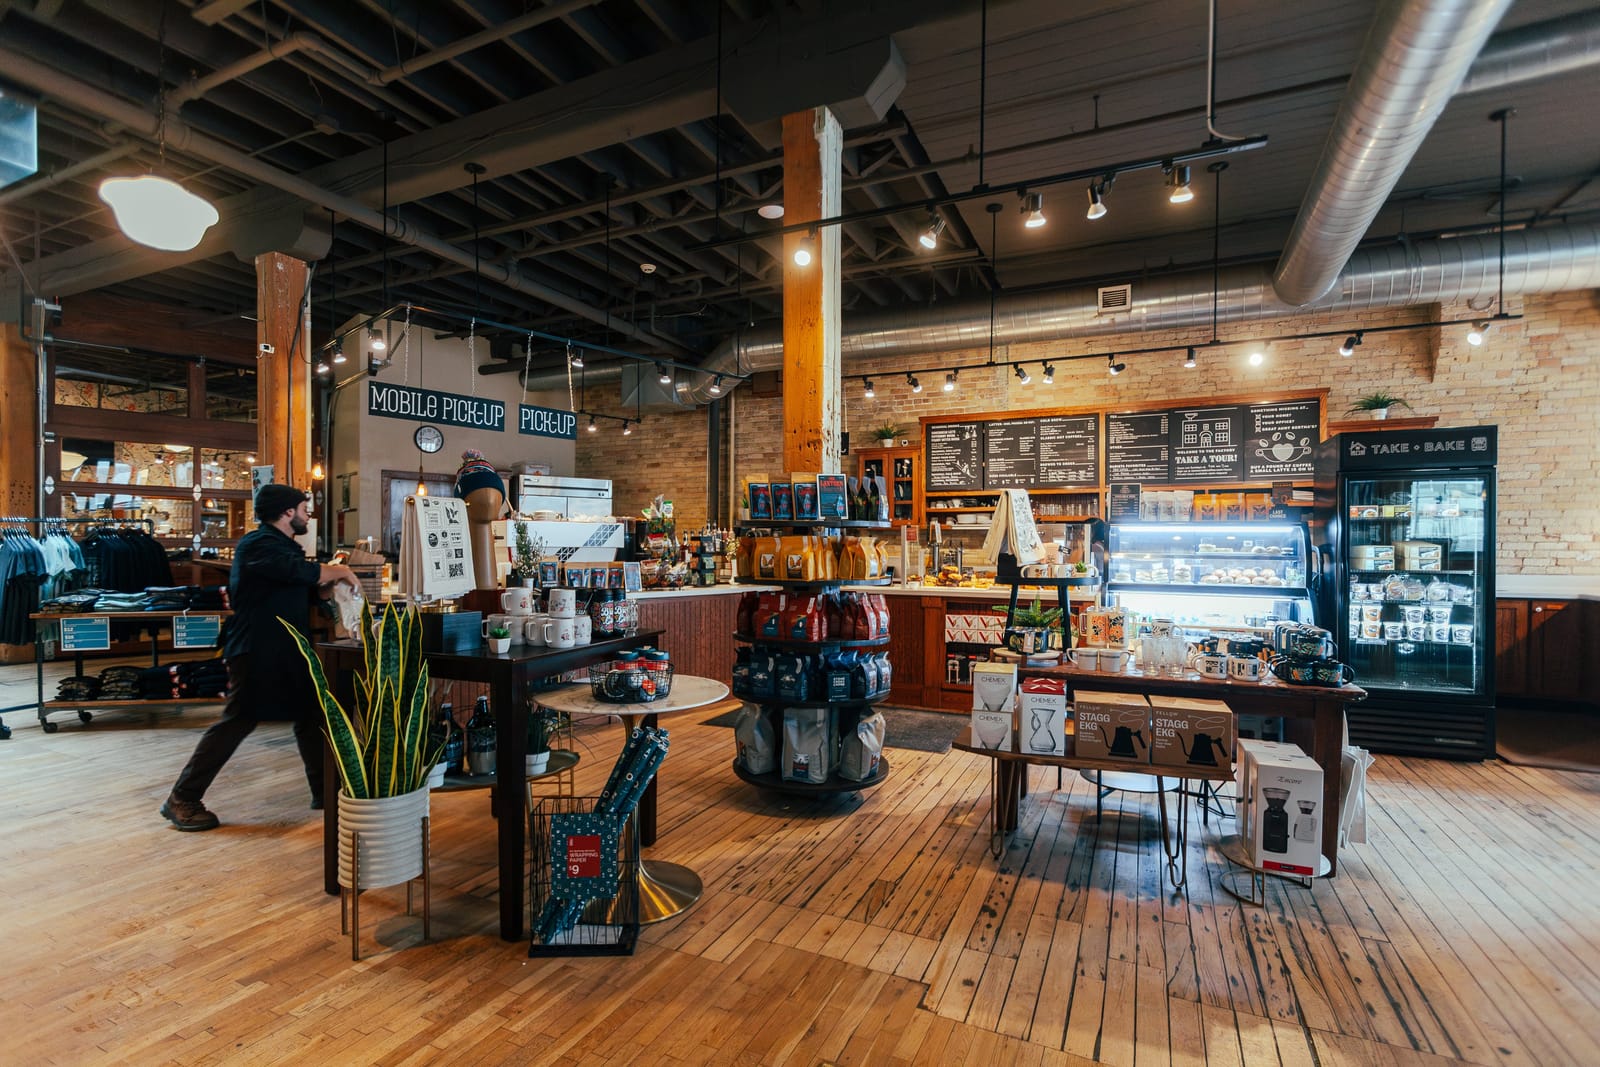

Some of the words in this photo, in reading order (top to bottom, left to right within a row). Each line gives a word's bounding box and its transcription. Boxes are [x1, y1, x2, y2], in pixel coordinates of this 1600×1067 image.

[370, 385, 437, 418] MOBILE
[442, 397, 504, 427] PICK-UP
[521, 408, 576, 436] PICK-UP
[1371, 442, 1410, 455] TAKE
[1424, 440, 1466, 452] BAKE
[1175, 456, 1199, 464] TAKE
[1209, 454, 1238, 463] TOUR!
[1080, 712, 1110, 722] STAGG
[1080, 722, 1097, 730] EKG
[1156, 718, 1188, 729] STAGG
[1156, 728, 1175, 737] EKG
[569, 865, 579, 874] $9
